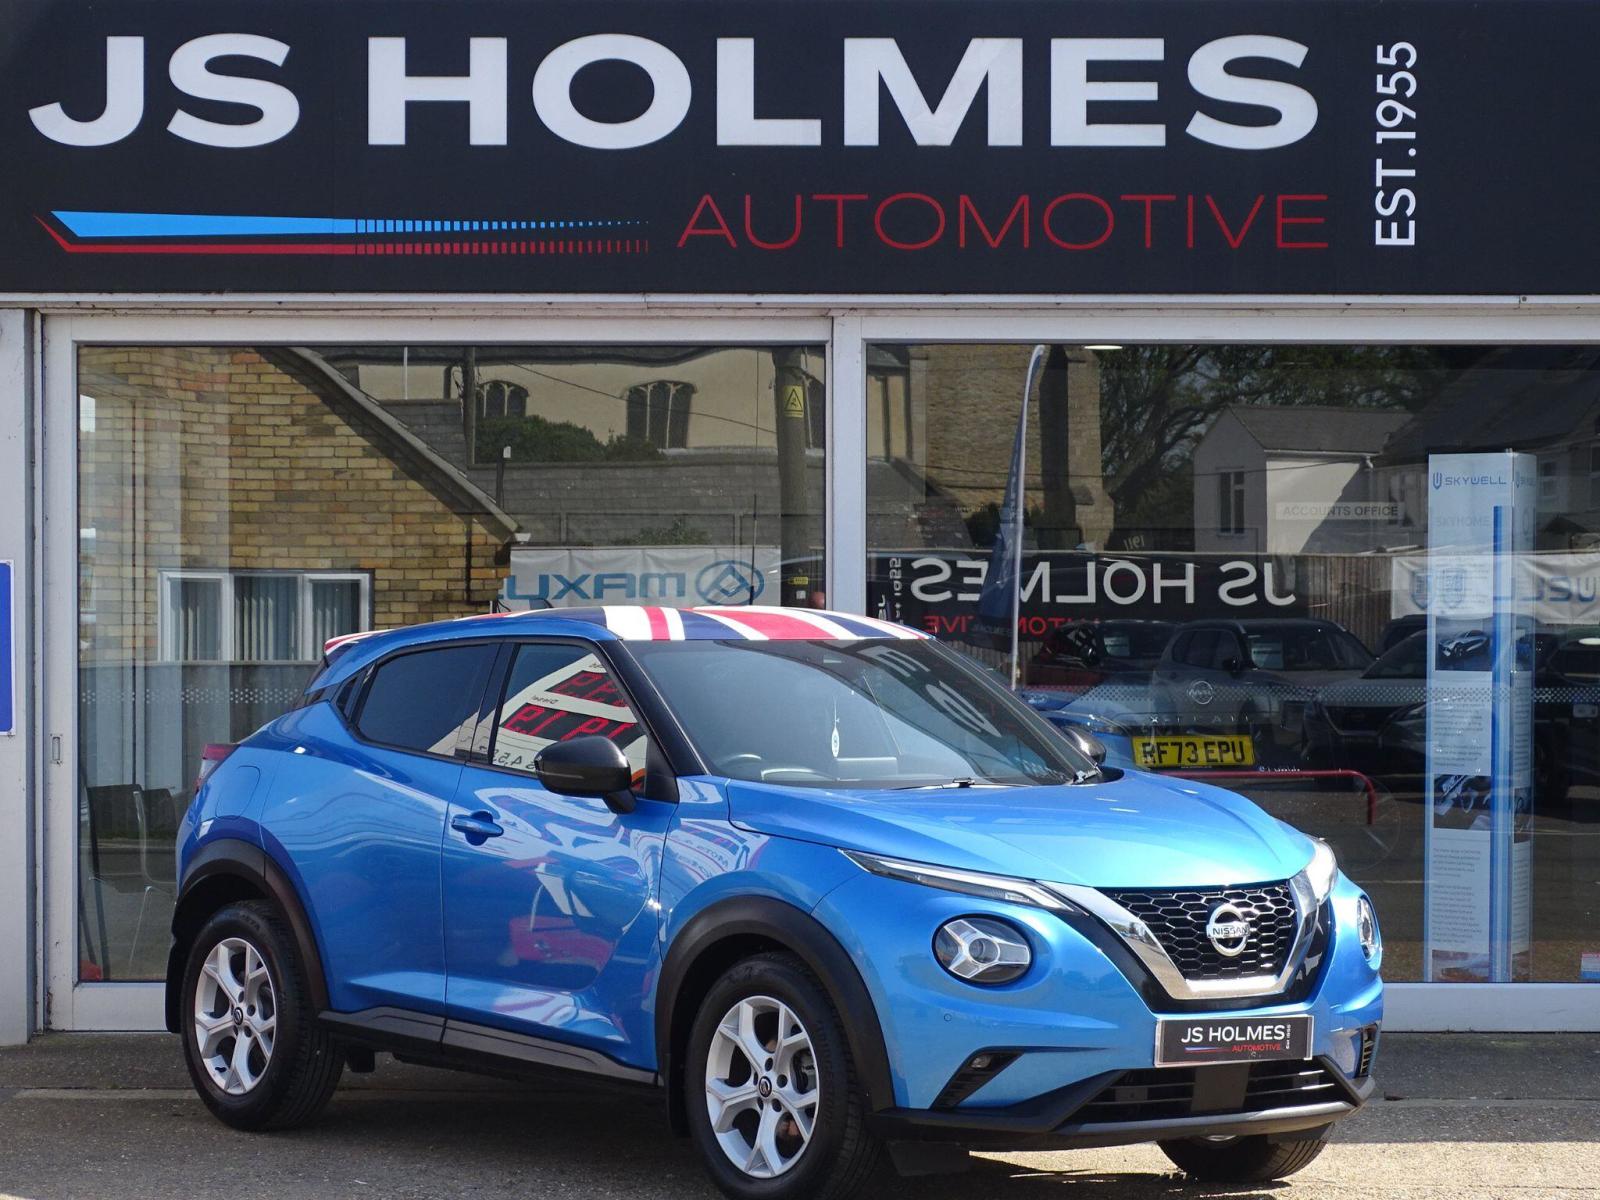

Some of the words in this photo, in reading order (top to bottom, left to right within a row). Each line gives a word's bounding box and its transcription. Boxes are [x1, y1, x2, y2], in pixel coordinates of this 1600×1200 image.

[28, 33, 300, 149] JS
[367, 33, 1319, 150] HOLMES
[1374, 40, 1417, 247] EST.1955
[677, 191, 1330, 250] AUTOMOTIVE
[1444, 475, 1508, 487] SKYWELL
[1282, 504, 1351, 518] ACCOUNTS
[1353, 504, 1400, 517] OFFICE
[1141, 741, 1199, 764] RF73
[1203, 740, 1246, 763] EPU
[1212, 925, 1248, 936] NISSAN
[1180, 1027, 1204, 1043] JS
[1208, 1024, 1286, 1042] HOLMES
[1231, 1042, 1282, 1053] AUTOMOTIVE
